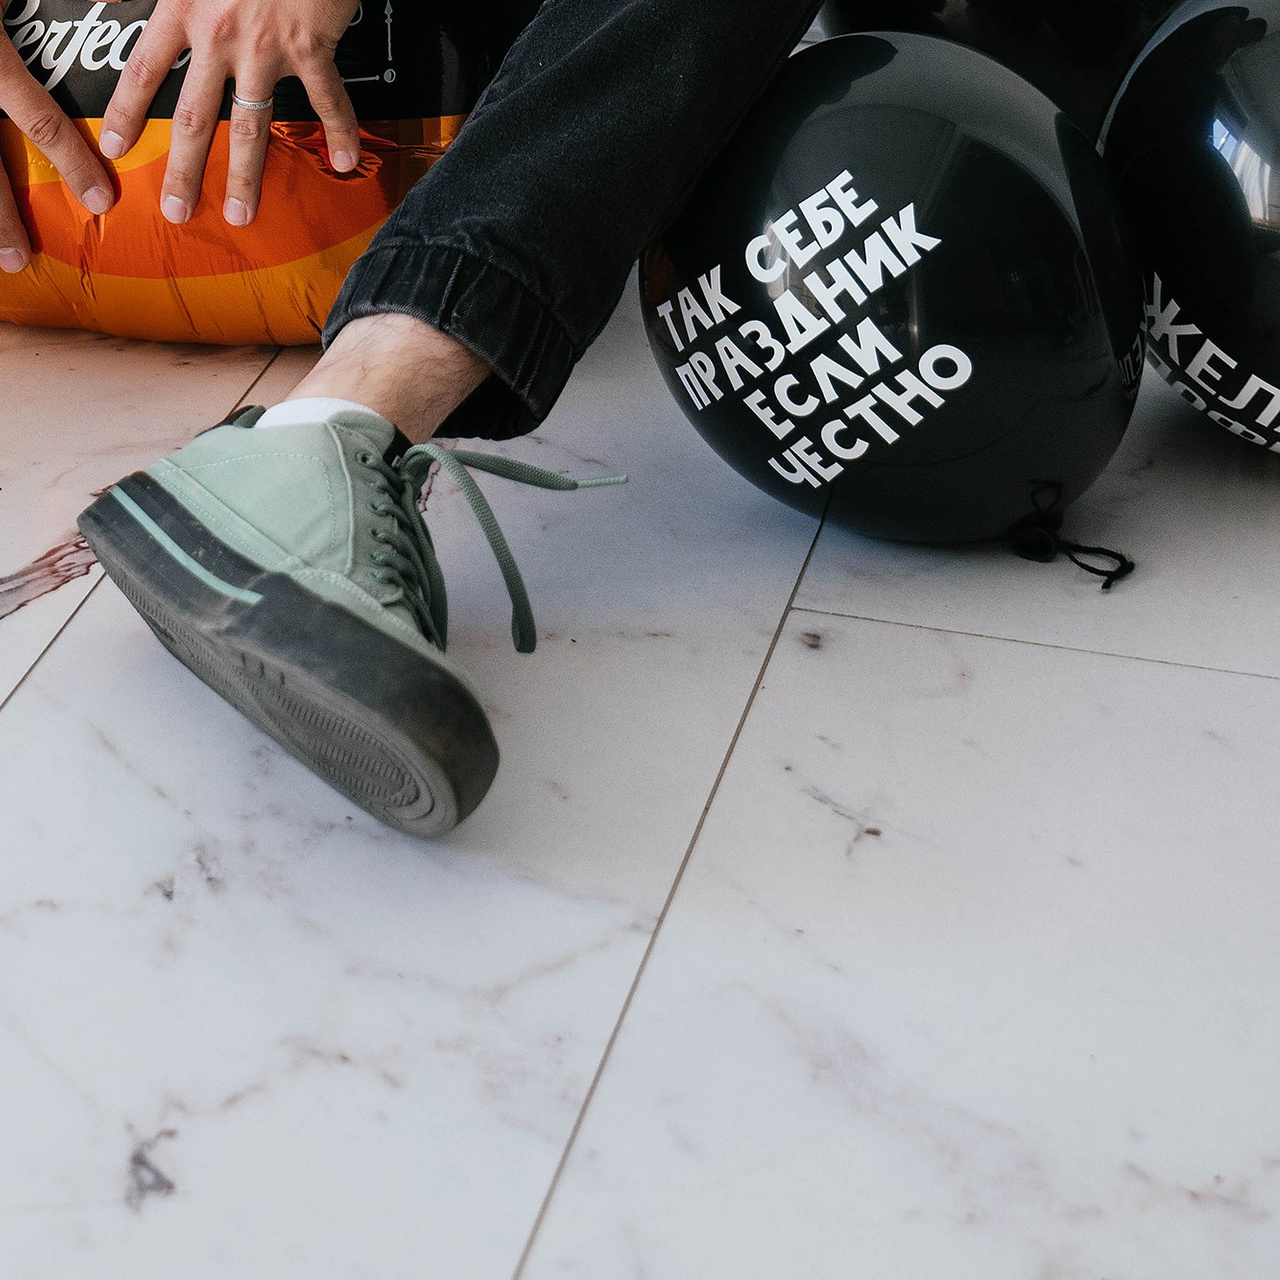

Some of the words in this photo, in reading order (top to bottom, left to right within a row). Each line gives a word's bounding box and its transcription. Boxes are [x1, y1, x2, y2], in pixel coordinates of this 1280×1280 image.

[656, 263, 742, 353] ТАК
[745, 169, 879, 283] СЕБЕ
[675, 202, 942, 411] ПРАЗДНИК
[742, 316, 904, 441] ЕСЛИ
[767, 344, 973, 489] ЧЕСТНО
[1144, 271, 1280, 433] ЖЕЛ
